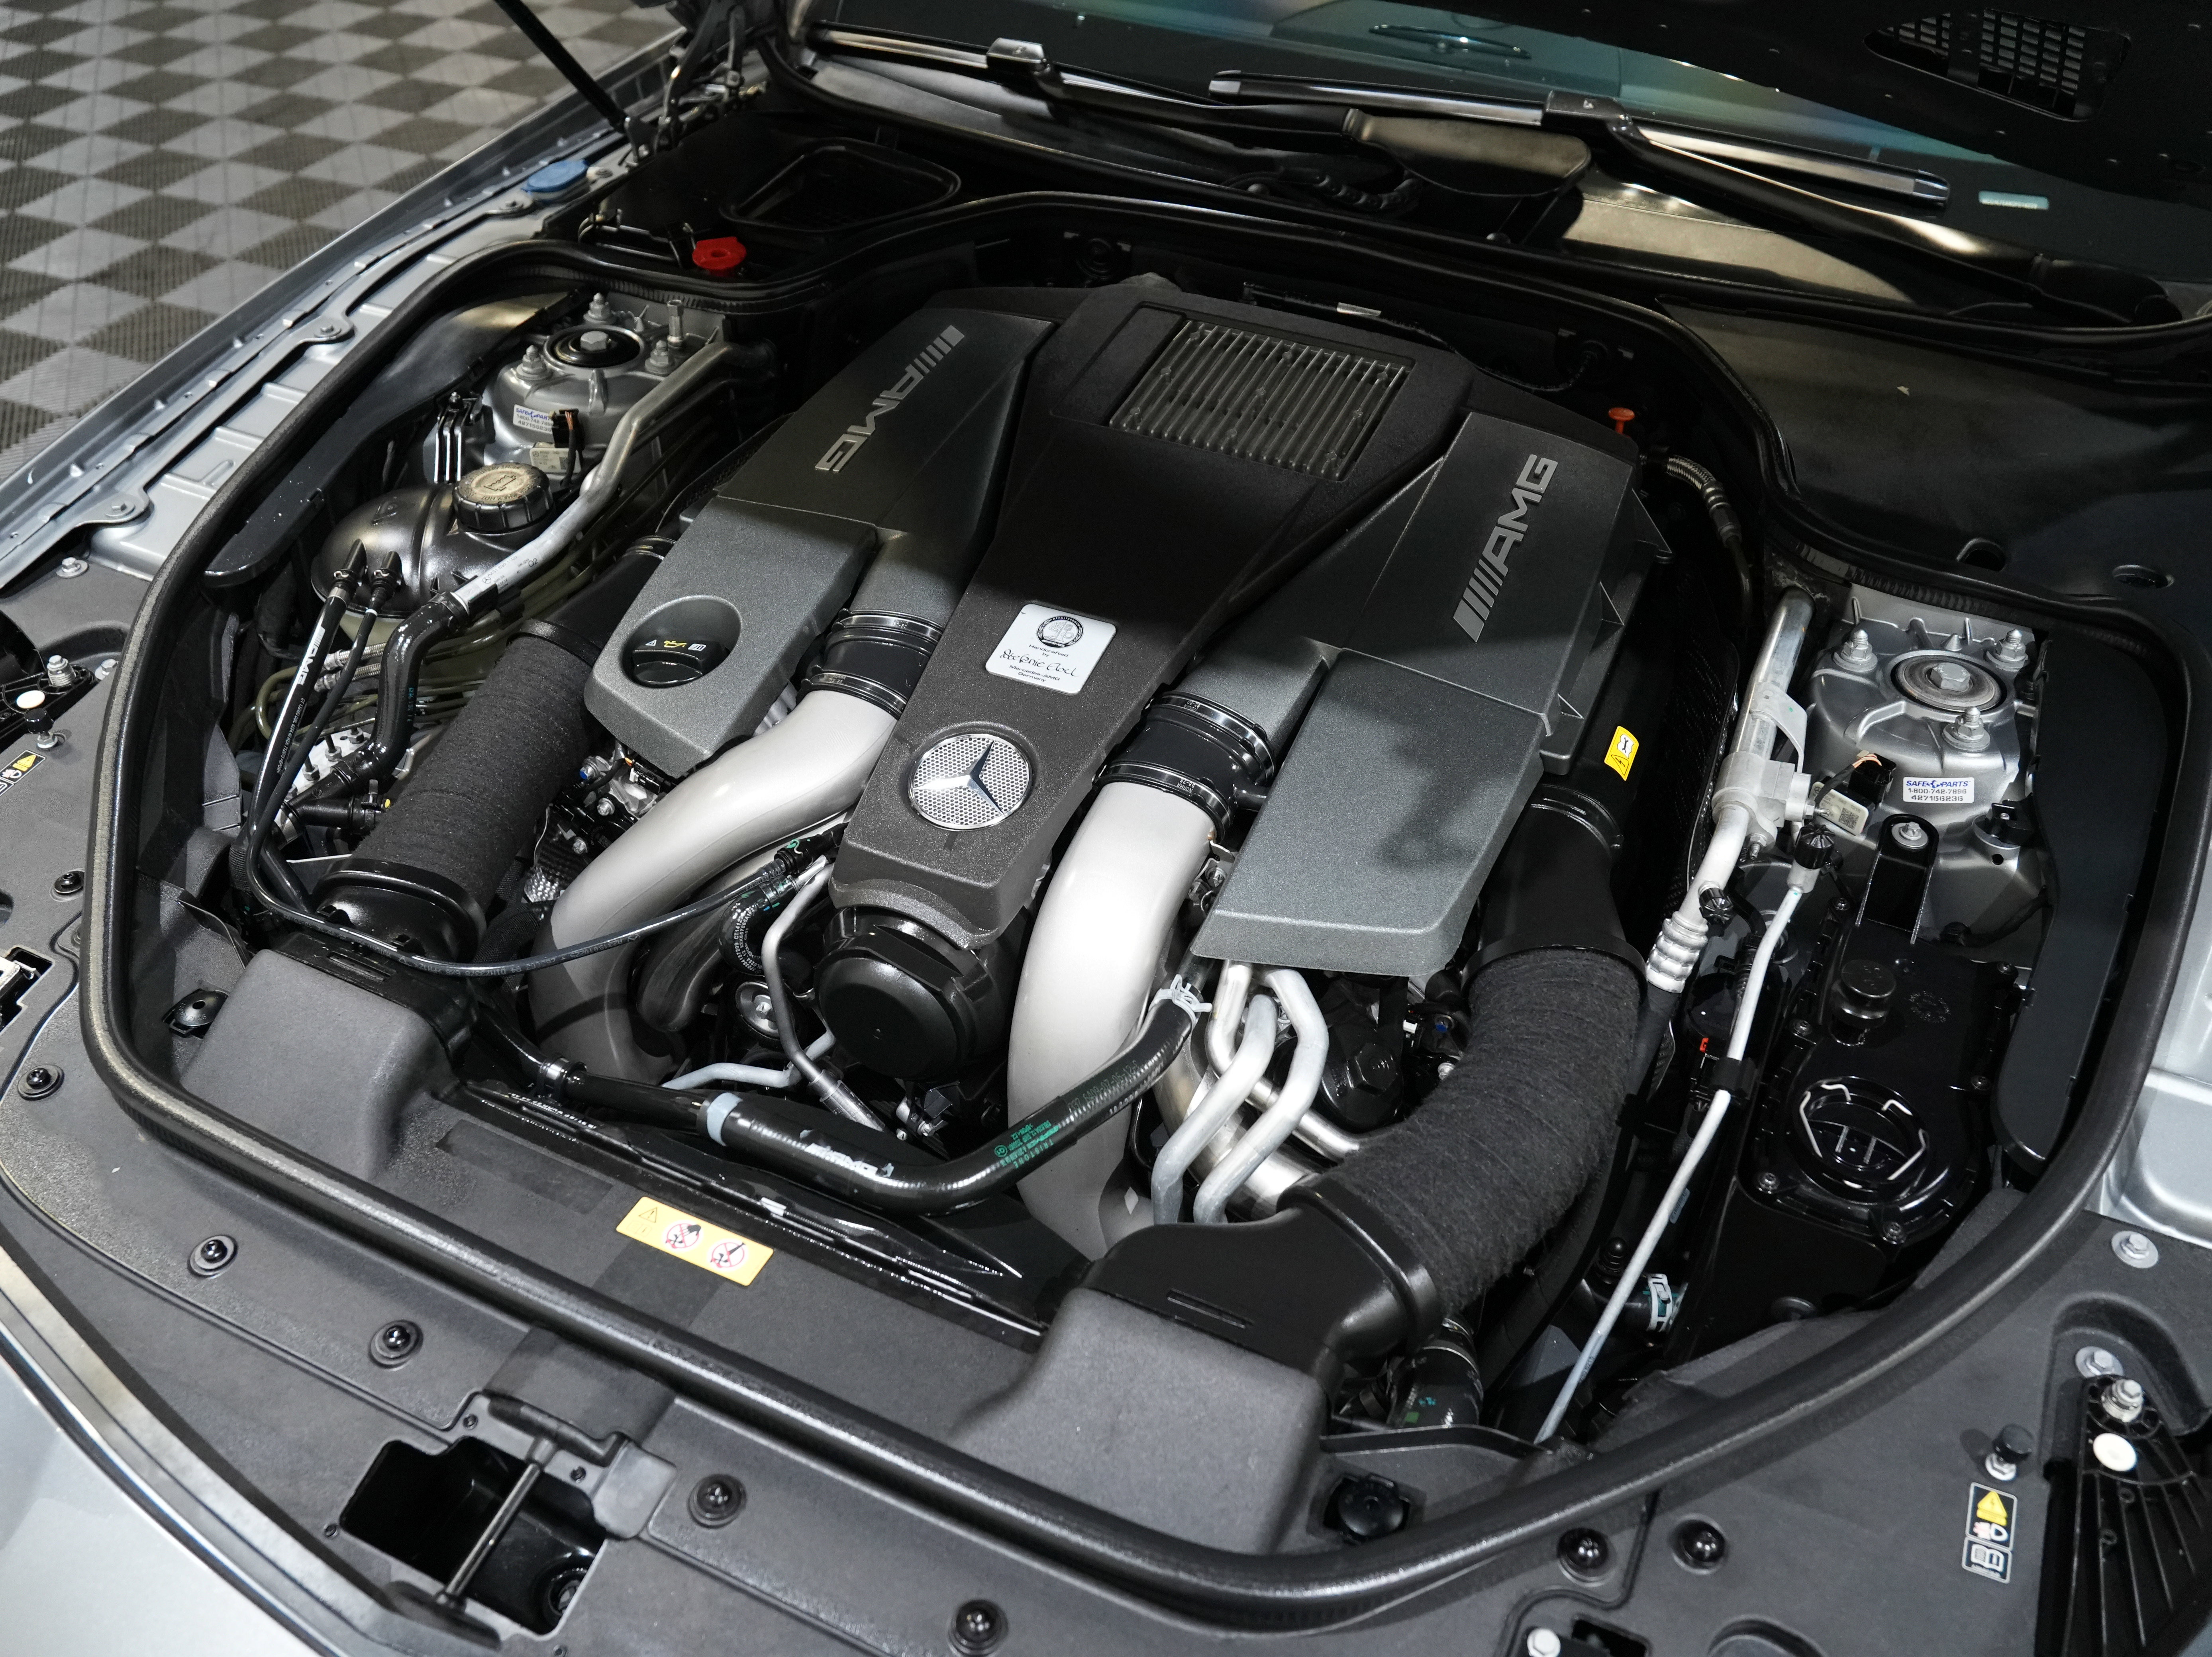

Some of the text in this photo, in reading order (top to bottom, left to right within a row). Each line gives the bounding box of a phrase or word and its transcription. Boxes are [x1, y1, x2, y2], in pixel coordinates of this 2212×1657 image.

[516, 408, 529, 417] SAFE
[528, 558, 538, 567] Q2
[1053, 617, 1081, 627] AFFALTERBACH
[1029, 644, 1069, 658] Handcrafted
[1009, 665, 1060, 681] Mercedes-AMG
[1018, 672, 1047, 682] Germany
[1177, 782, 1194, 793] NORMA
[1012, 1138, 1054, 1169] TRISTONE
